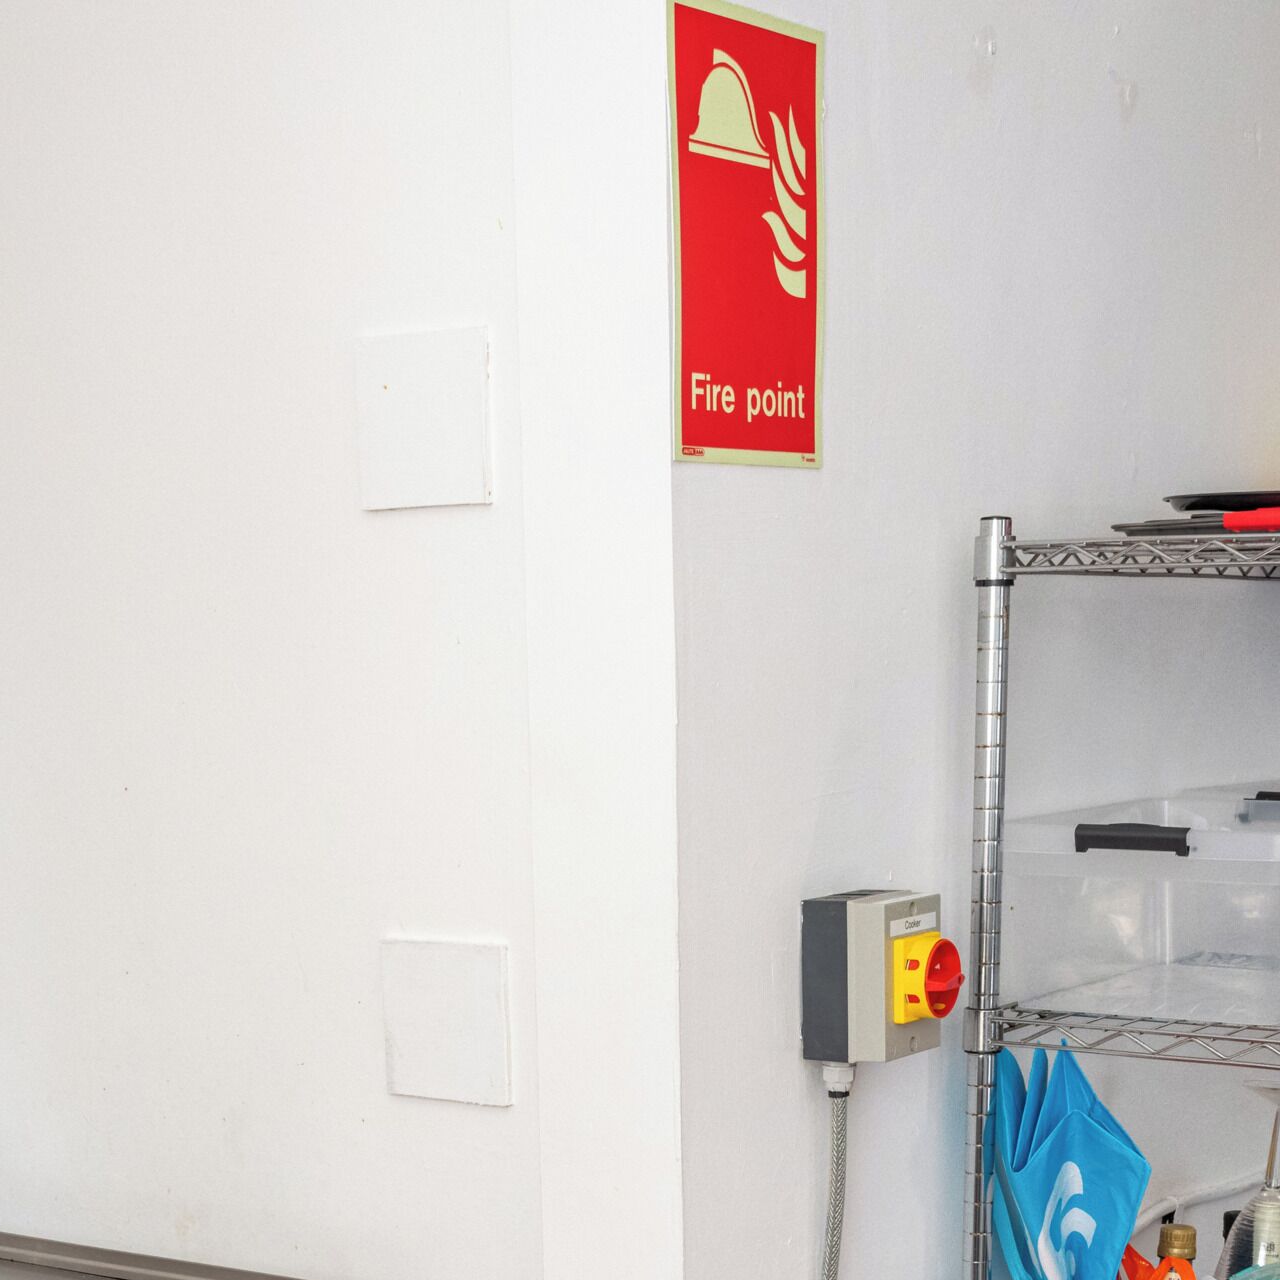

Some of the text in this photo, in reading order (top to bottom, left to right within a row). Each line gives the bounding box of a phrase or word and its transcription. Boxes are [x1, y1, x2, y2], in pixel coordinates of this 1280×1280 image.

[691, 371, 805, 423] Fire point
[904, 919, 921, 930] Cooker
